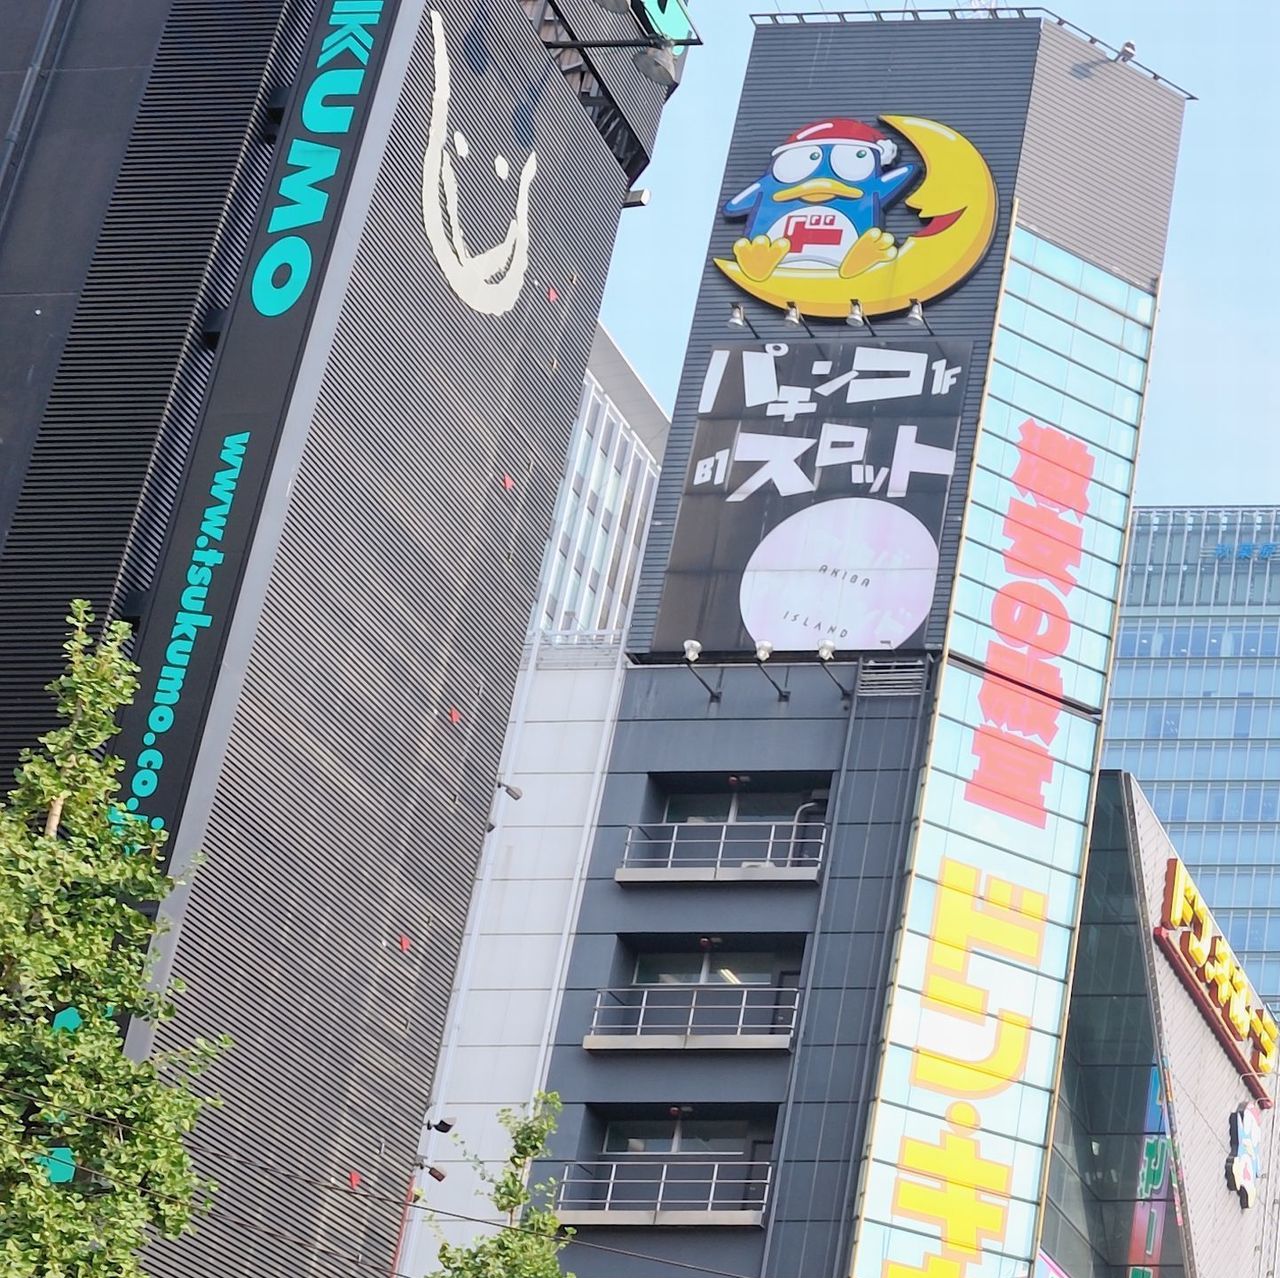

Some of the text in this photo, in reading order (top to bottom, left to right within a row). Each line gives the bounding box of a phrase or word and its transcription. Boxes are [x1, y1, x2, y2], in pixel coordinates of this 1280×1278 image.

[252, 0, 384, 318] KUMO
[698, 343, 928, 422] パチンコ
[726, 423, 957, 502] スロット
[818, 563, 870, 588] AKIBA
[783, 610, 849, 639] ISLAND
